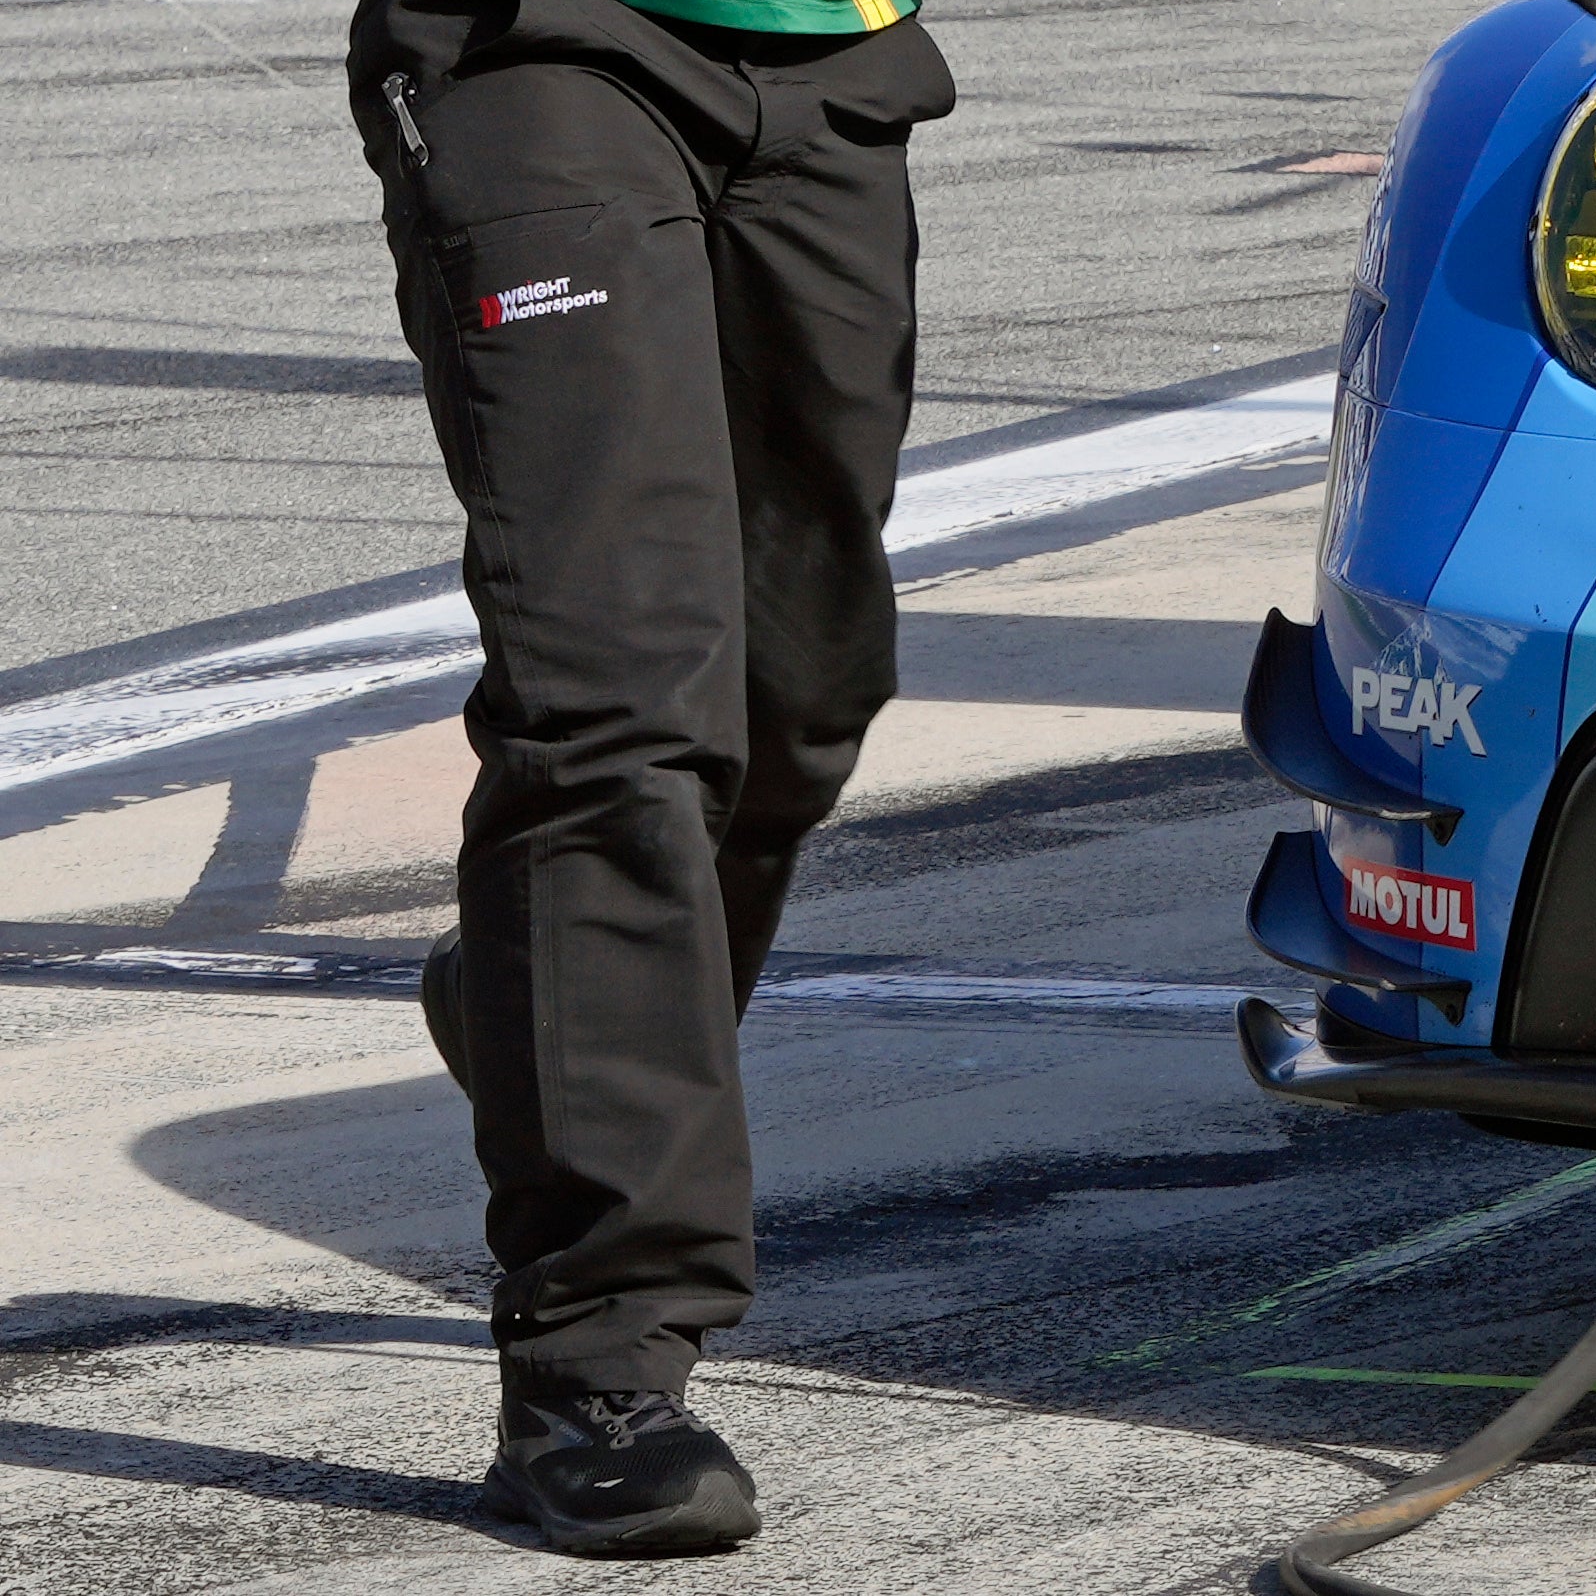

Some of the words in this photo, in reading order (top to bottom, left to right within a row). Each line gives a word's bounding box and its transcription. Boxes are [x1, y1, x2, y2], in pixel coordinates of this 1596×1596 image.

[500, 289, 609, 324] Motorsports
[1351, 666, 1488, 757] PEAK
[1348, 868, 1470, 940] MOTUL
